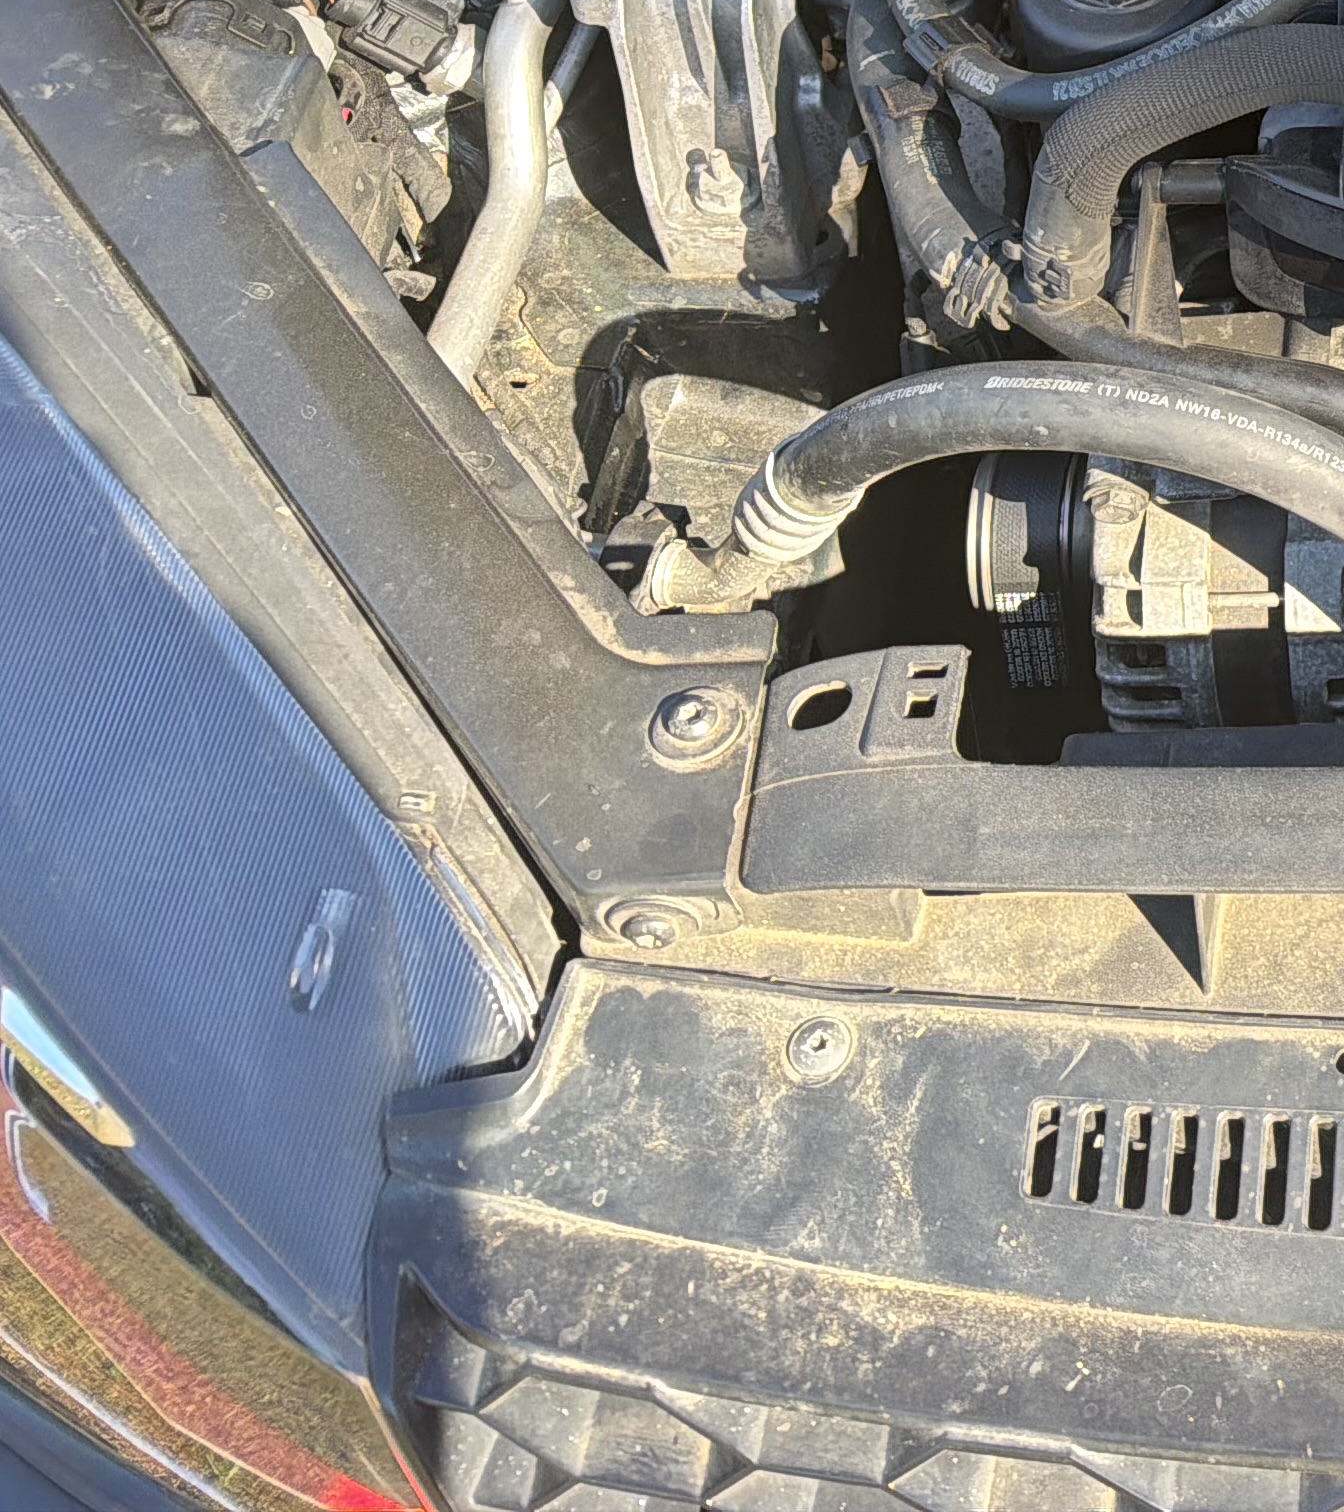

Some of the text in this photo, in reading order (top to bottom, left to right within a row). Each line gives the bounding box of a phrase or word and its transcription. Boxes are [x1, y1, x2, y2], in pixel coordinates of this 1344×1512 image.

[983, 375, 1093, 394] BRIDGESTONE
[1097, 383, 1121, 398] (T)
[1125, 388, 1170, 408] ND2A
